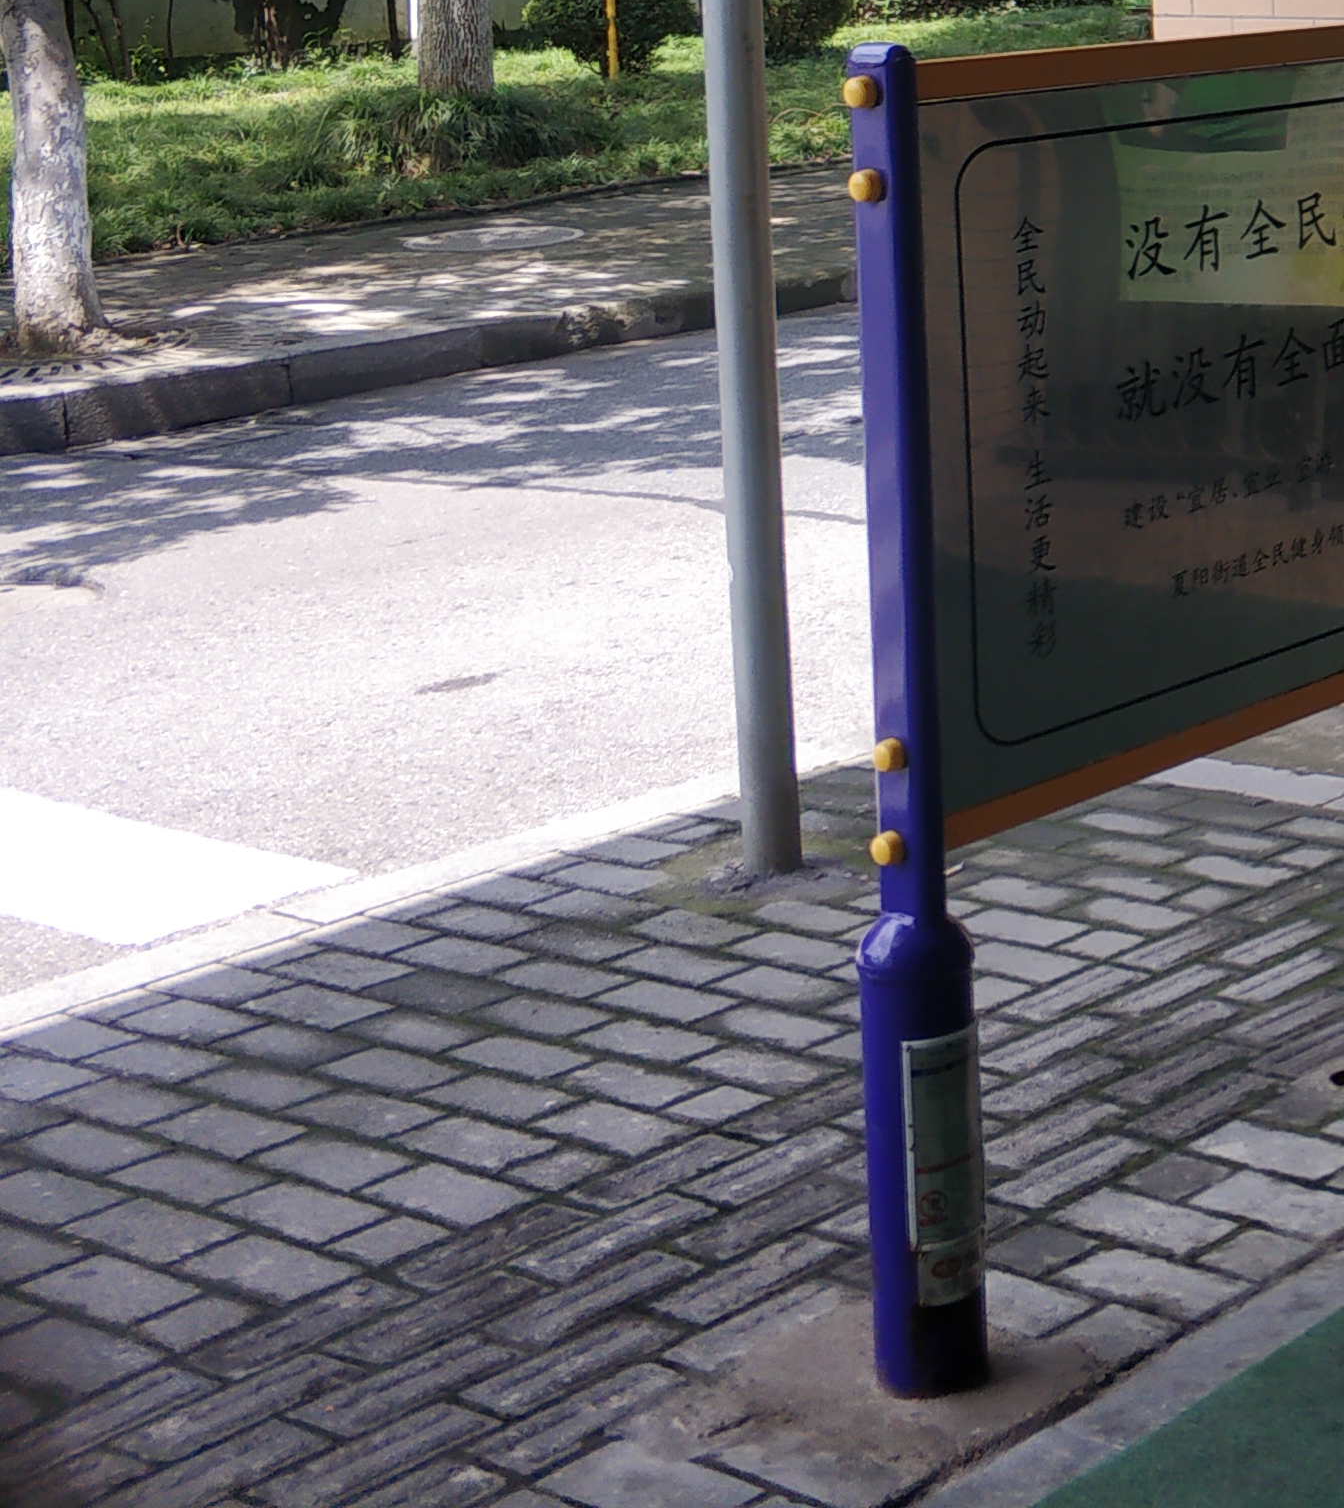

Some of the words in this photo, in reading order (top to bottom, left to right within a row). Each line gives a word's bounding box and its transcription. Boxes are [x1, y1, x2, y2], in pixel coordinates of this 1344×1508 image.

[1011, 215, 1052, 424] 全民动起来
[1023, 449, 1058, 660] 生活更精彩
